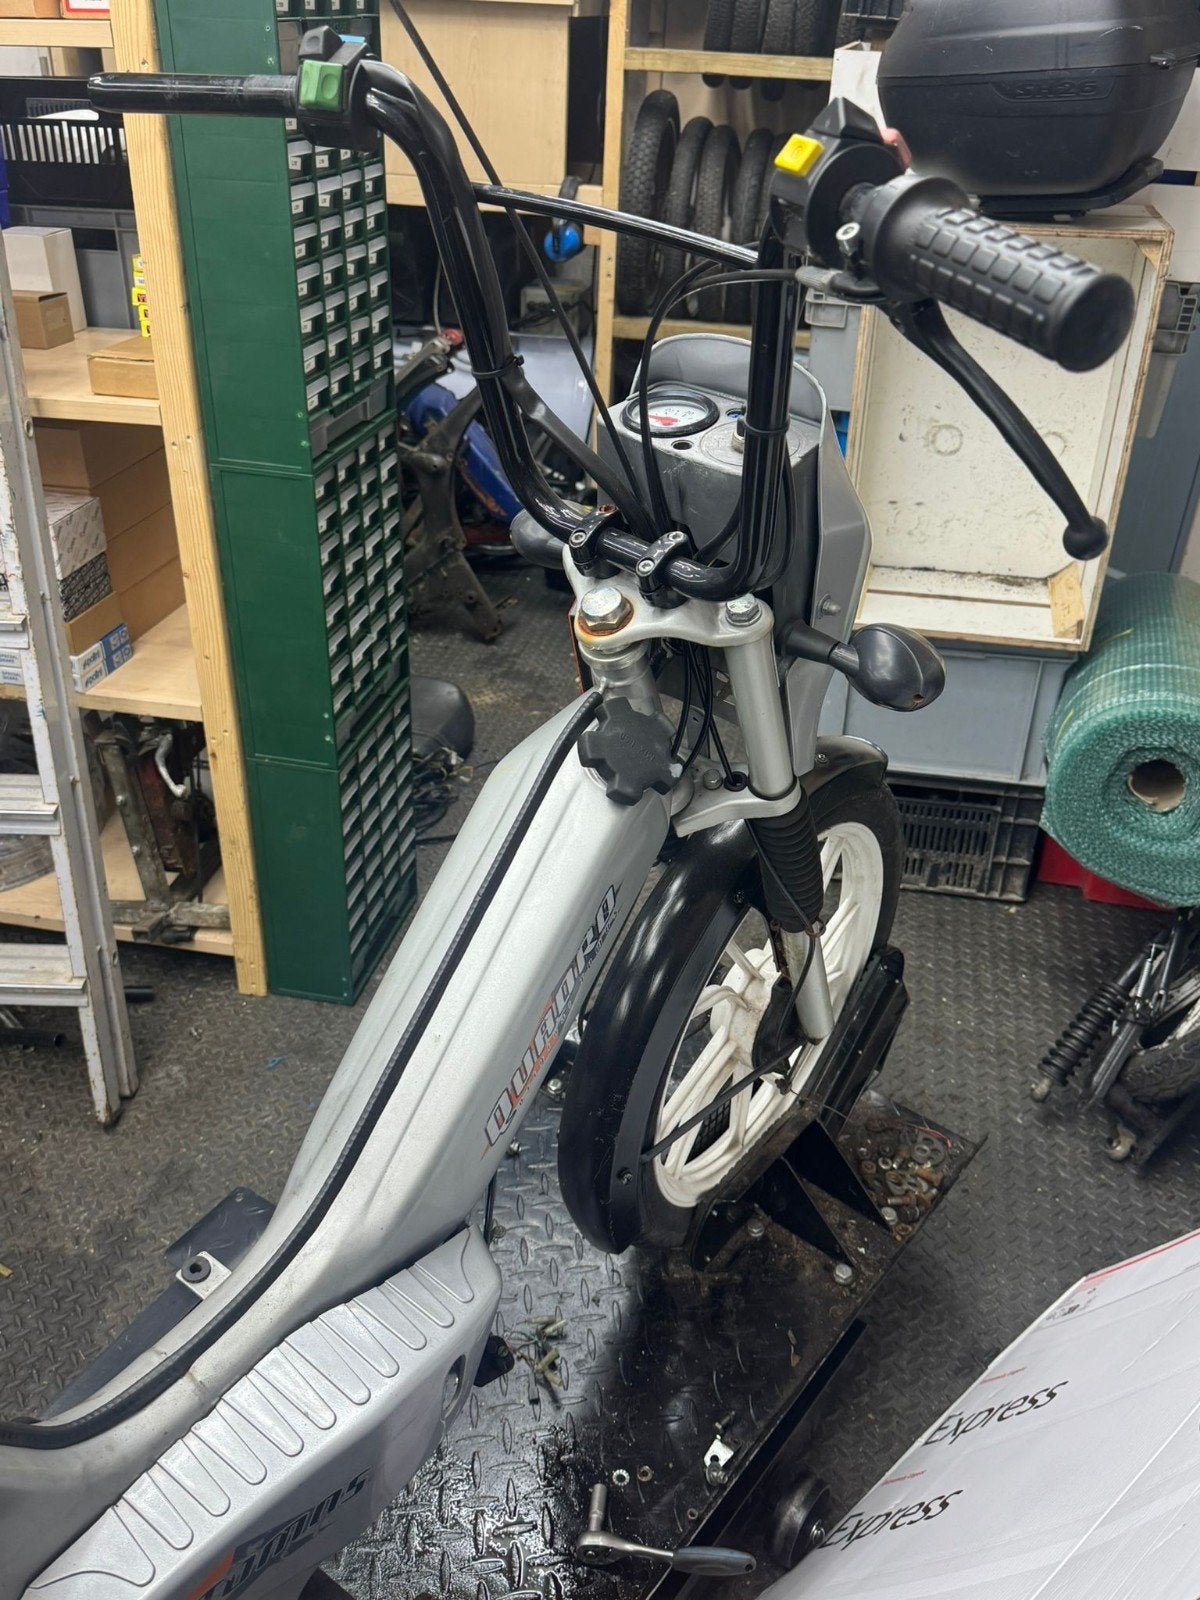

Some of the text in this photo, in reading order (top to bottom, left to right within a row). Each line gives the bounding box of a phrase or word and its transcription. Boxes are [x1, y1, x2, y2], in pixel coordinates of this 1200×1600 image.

[484, 884, 617, 1147] QUADRO
[922, 1381, 1069, 1447] Express
[818, 1490, 964, 1551] Express
